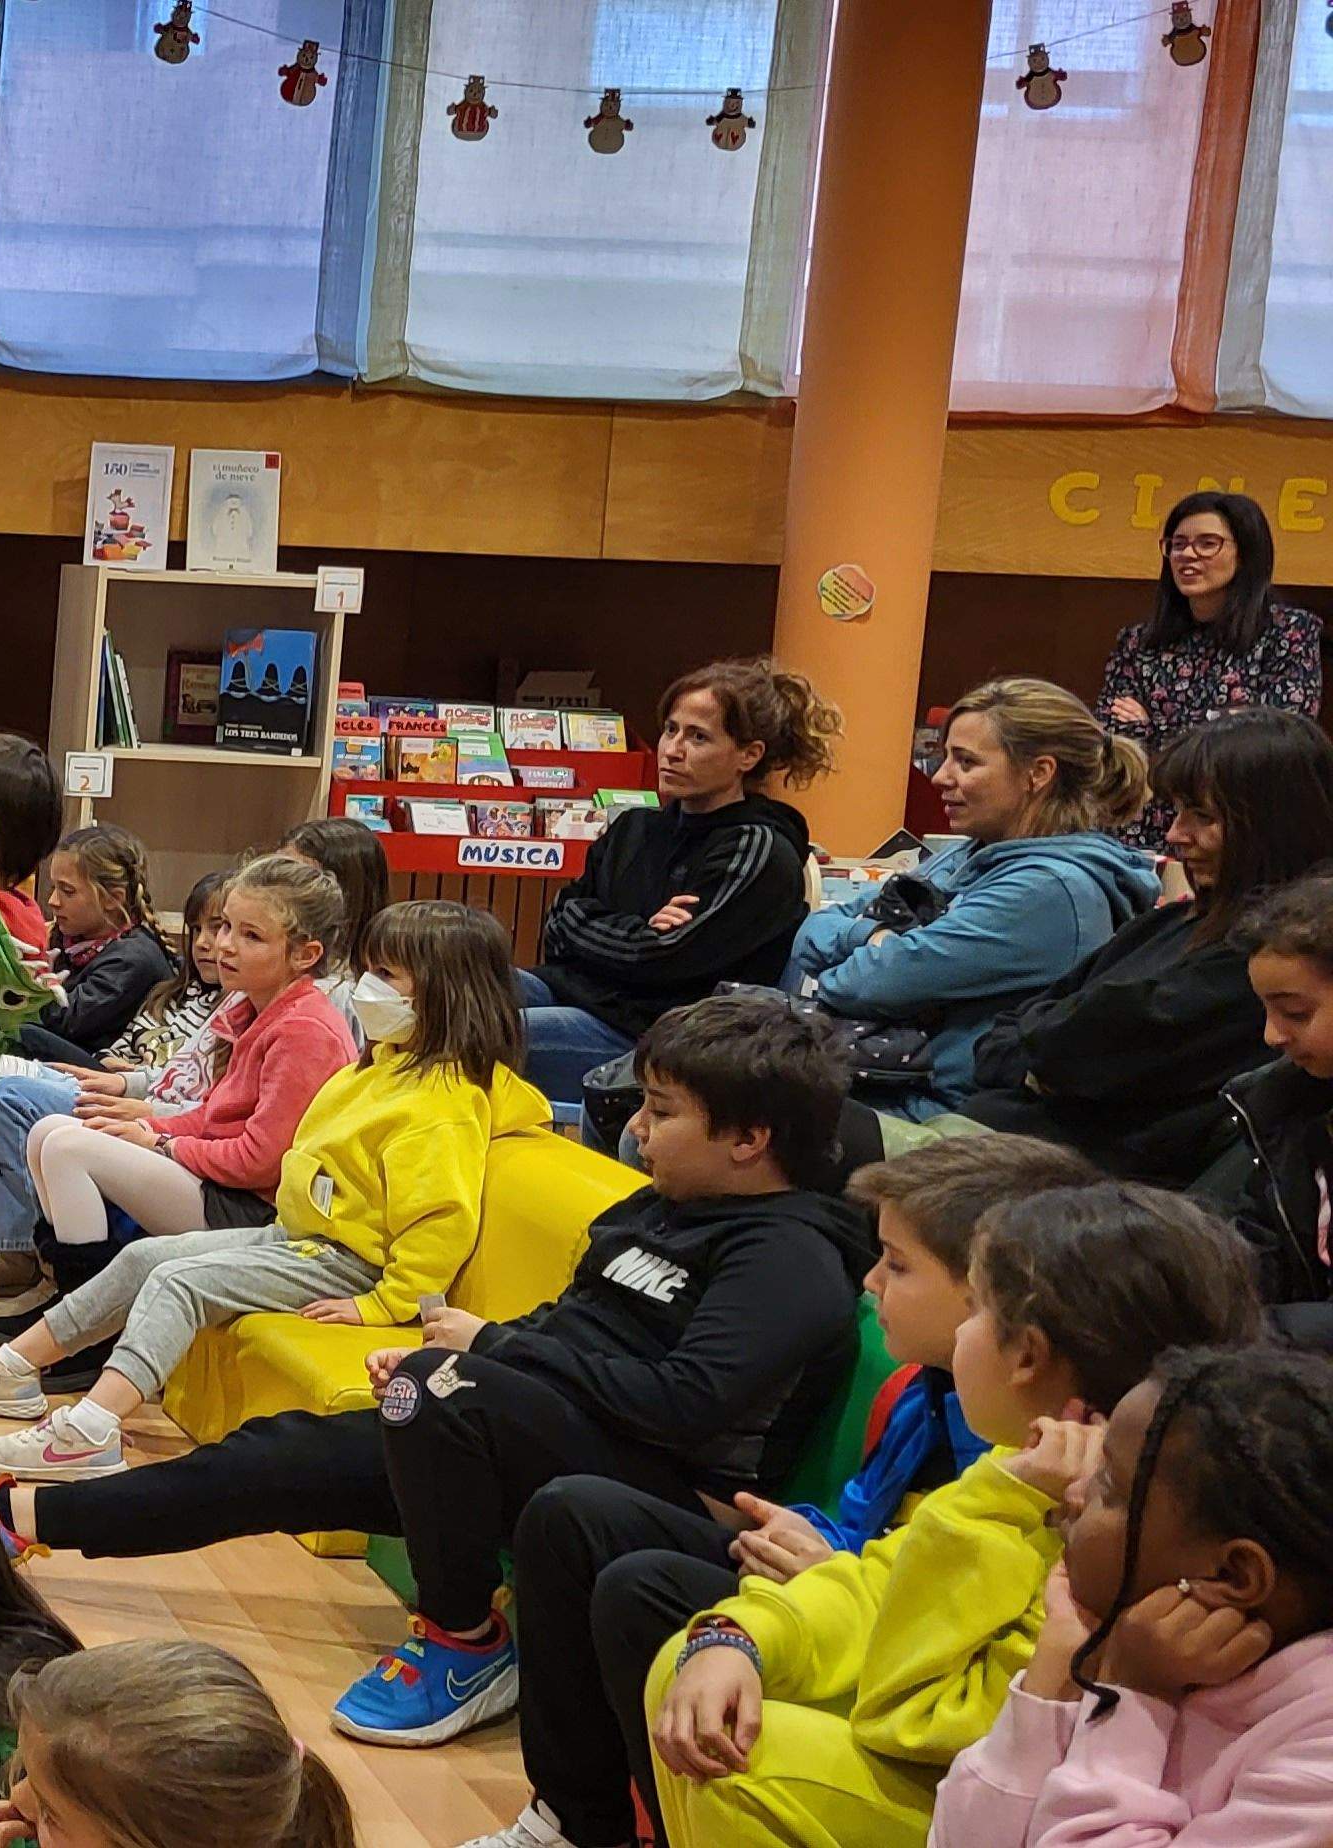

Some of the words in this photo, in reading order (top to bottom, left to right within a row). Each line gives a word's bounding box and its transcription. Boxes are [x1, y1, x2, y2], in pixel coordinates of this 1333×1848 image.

[215, 470, 227, 481] de
[225, 727, 239, 737] LOS
[240, 729, 259, 739] TRES
[80, 774, 91, 791] 2
[461, 842, 560, 867] MÚSICA
[601, 1246, 690, 1304] NIKE
